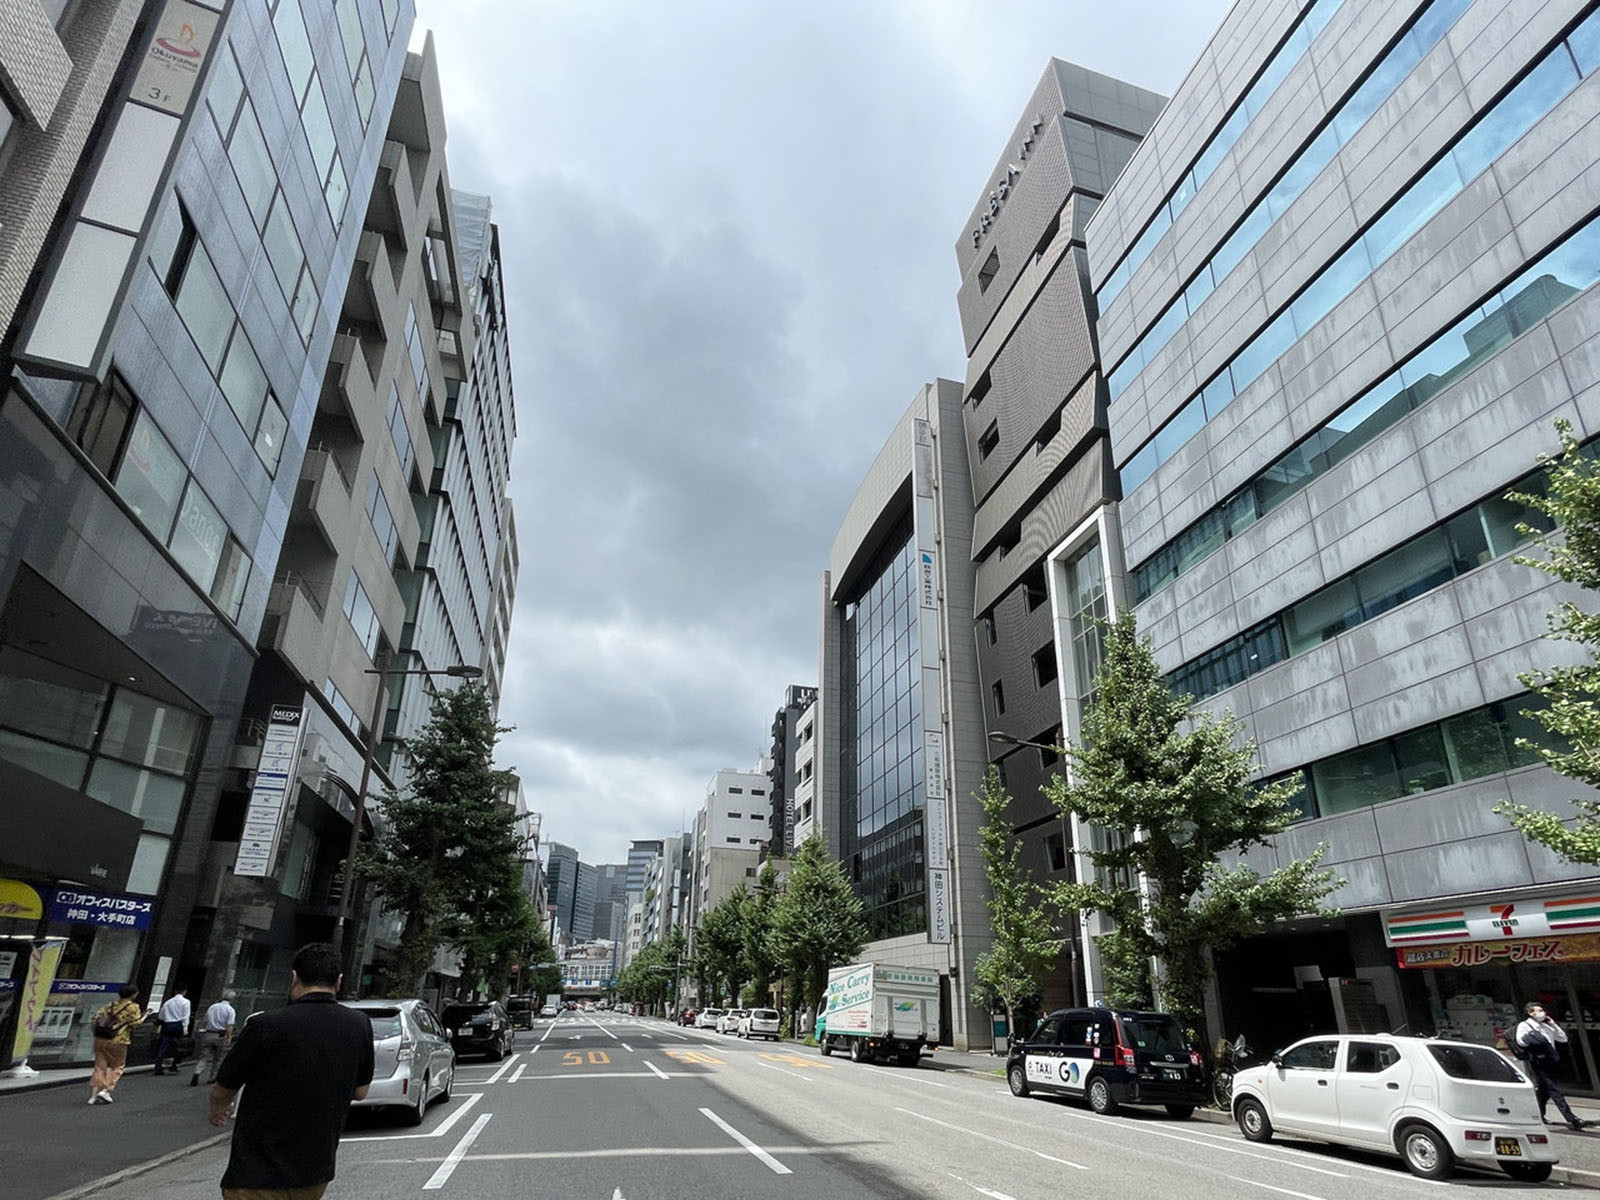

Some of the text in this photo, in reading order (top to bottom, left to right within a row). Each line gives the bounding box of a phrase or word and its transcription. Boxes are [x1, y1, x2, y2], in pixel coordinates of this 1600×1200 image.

[151, 47, 199, 68] Okuyama
[785, 798, 794, 826] HOTEL
[67, 908, 136, 926] 神田・大手町店
[934, 872, 945, 941] 神田システムビル
[1451, 940, 1565, 967] カレーフェス
[829, 983, 845, 995] Nice
[847, 973, 870, 988] Carry
[841, 990, 870, 1006] Service
[561, 1051, 611, 1065] 50
[1035, 1061, 1080, 1083] TAXI GO
